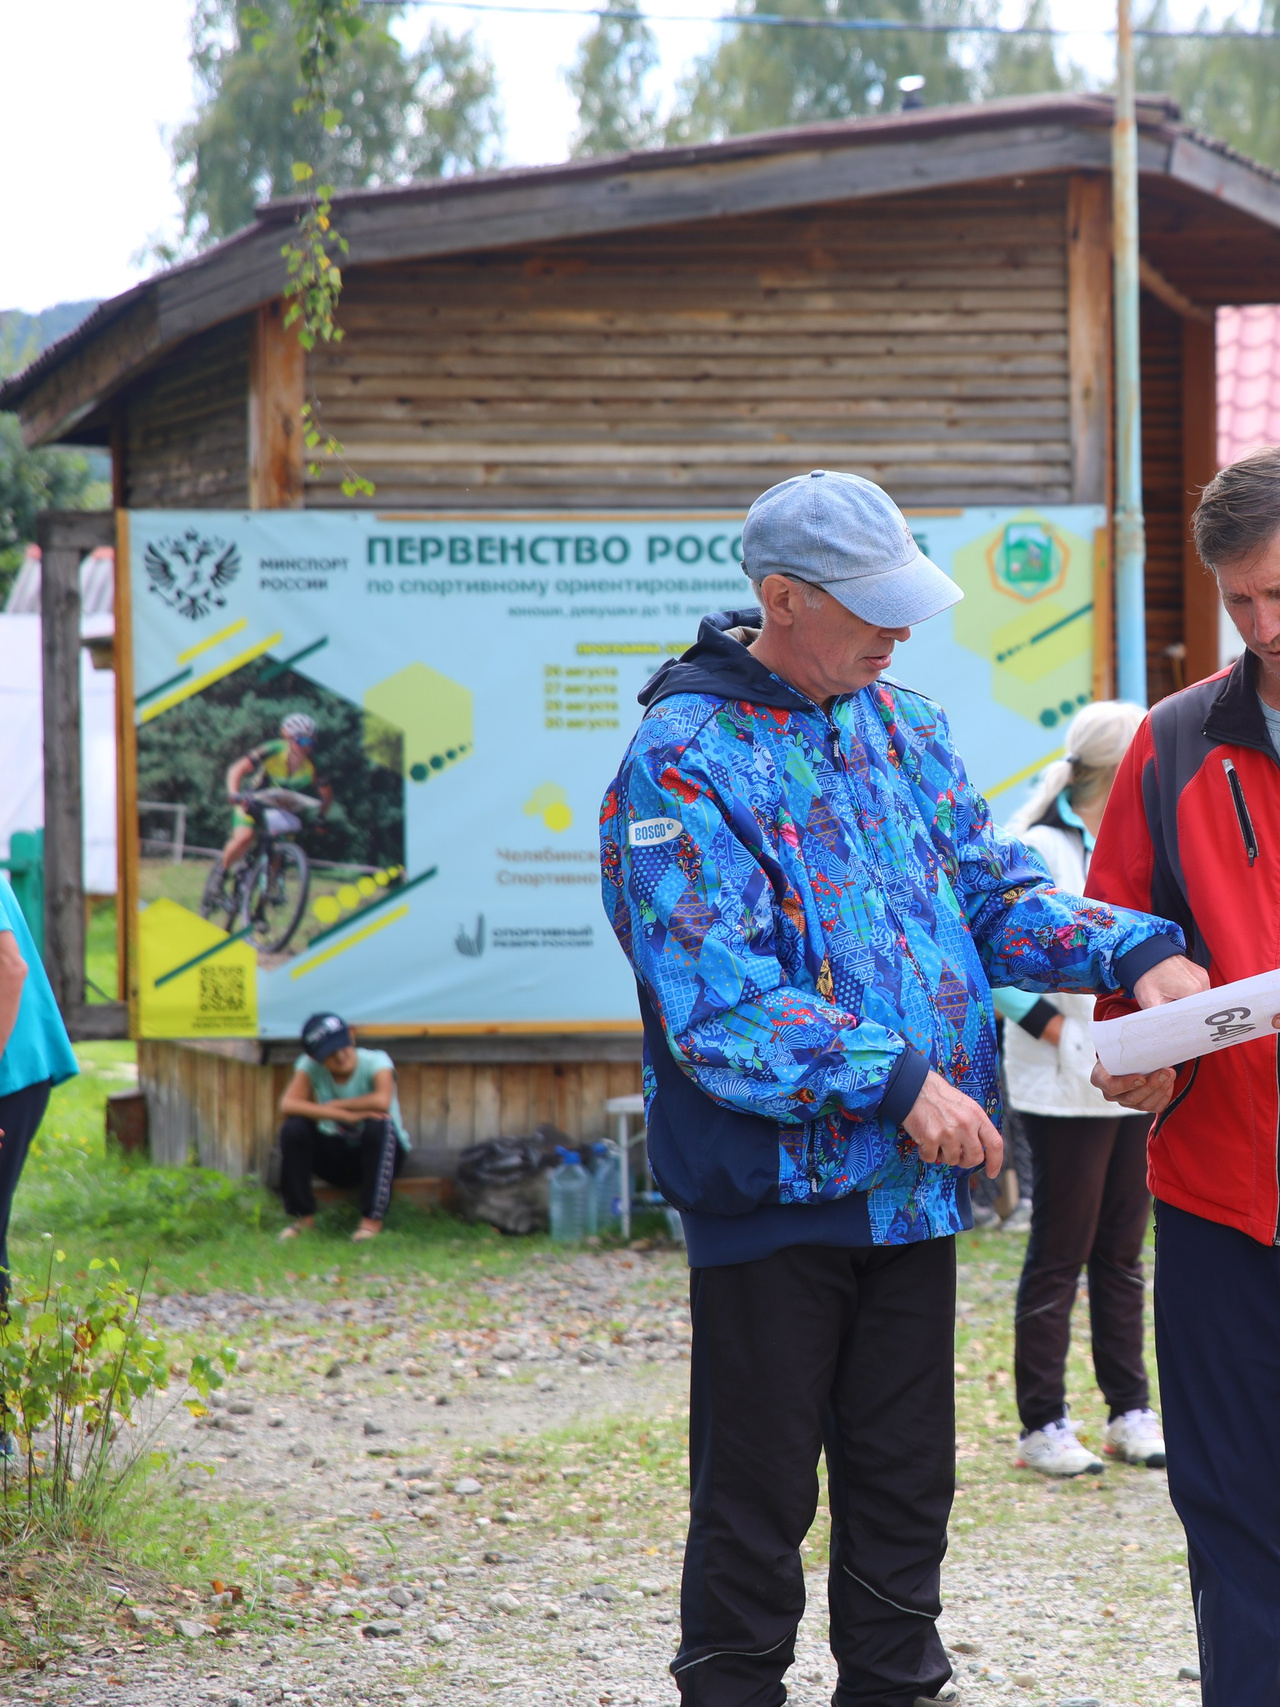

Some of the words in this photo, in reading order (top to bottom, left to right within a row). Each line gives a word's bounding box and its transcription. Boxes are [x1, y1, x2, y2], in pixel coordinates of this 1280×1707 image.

[366, 534, 631, 566] ПЕРВЕНСТВО
[647, 534, 743, 566] РОСС
[259, 557, 348, 573] МИНСПОРТ
[260, 577, 329, 592] РОССИИ
[367, 579, 394, 596] по
[400, 576, 549, 598] спортивному
[556, 576, 748, 598] ориентированию
[635, 822, 667, 841] BOSCO
